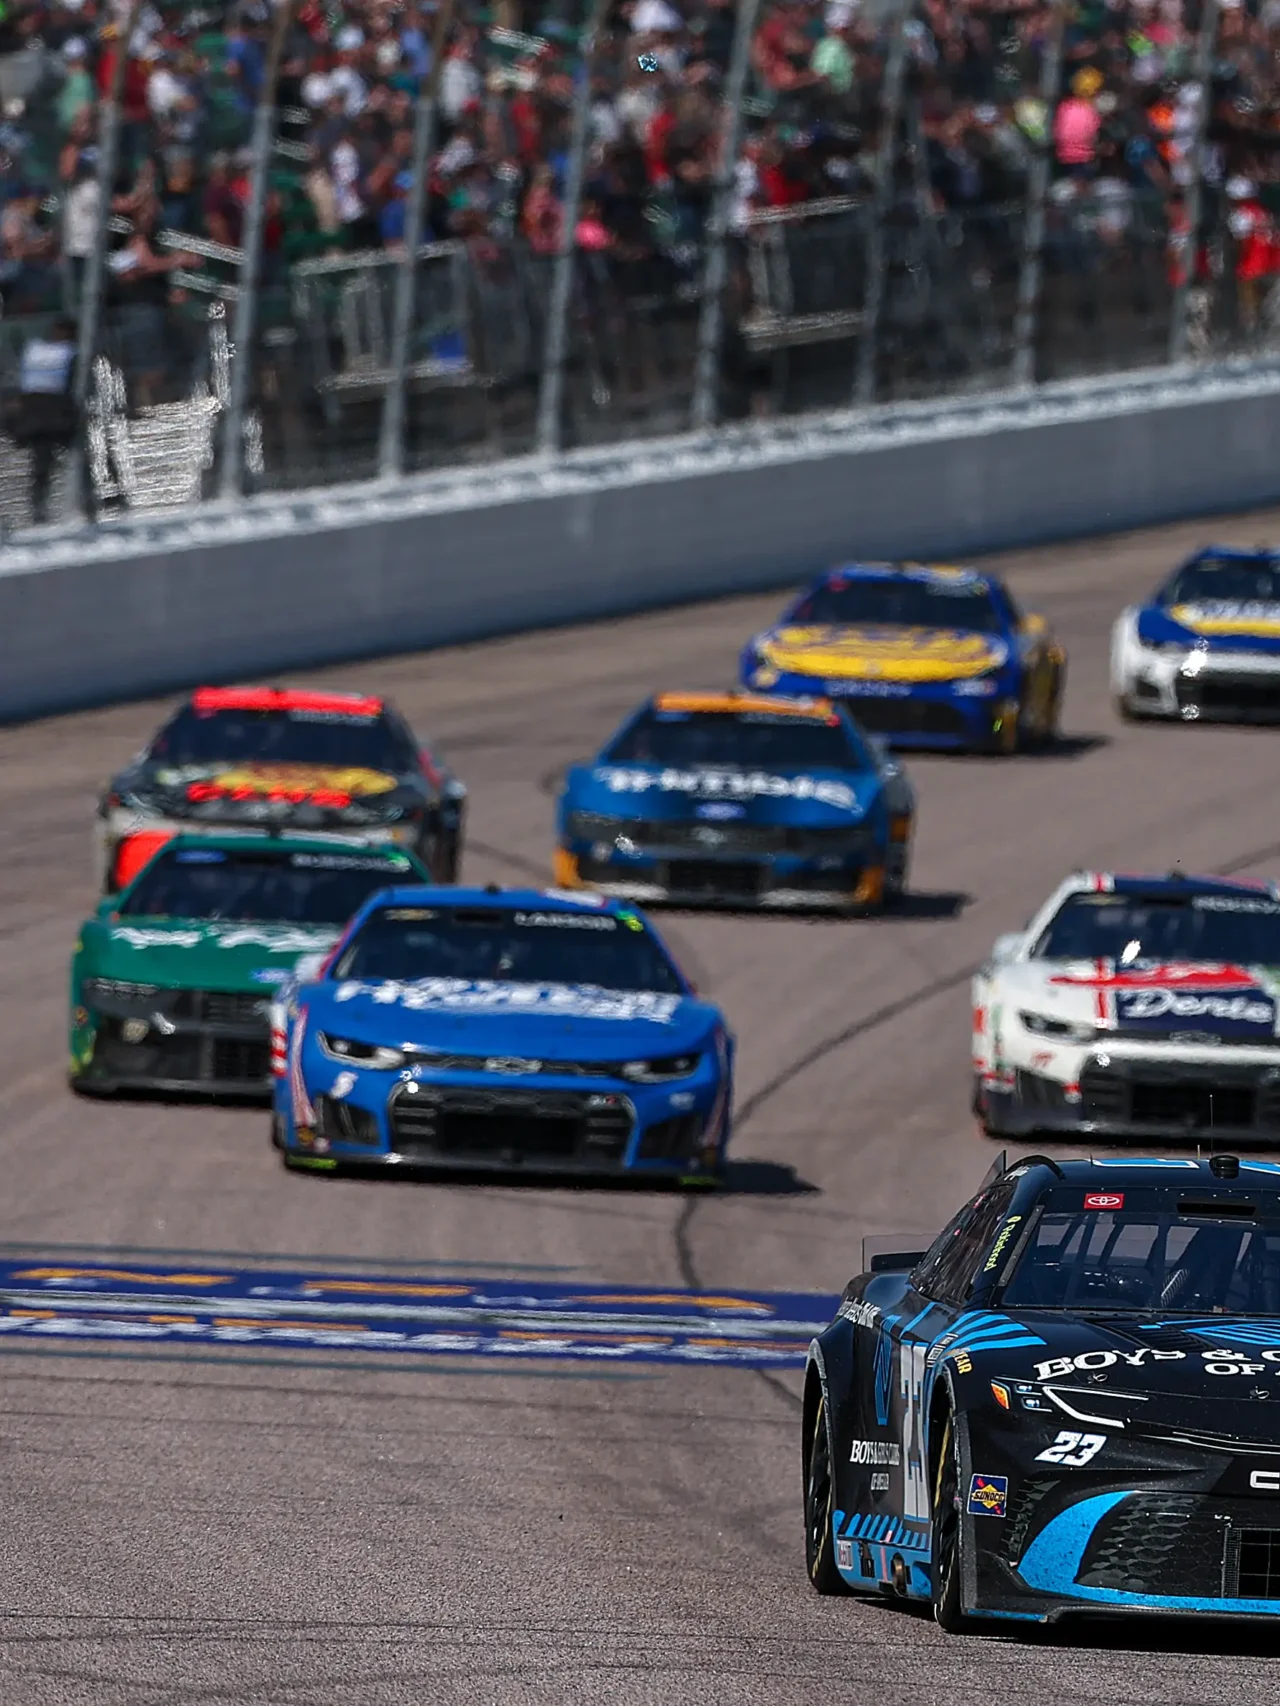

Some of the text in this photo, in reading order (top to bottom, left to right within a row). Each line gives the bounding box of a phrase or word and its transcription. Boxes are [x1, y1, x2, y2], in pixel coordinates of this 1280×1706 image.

[1033, 1349, 1187, 1381] BOYS
[1201, 1349, 1252, 1361] &
[1204, 1363, 1266, 1376] OF
[1034, 1431, 1107, 1467] 23
